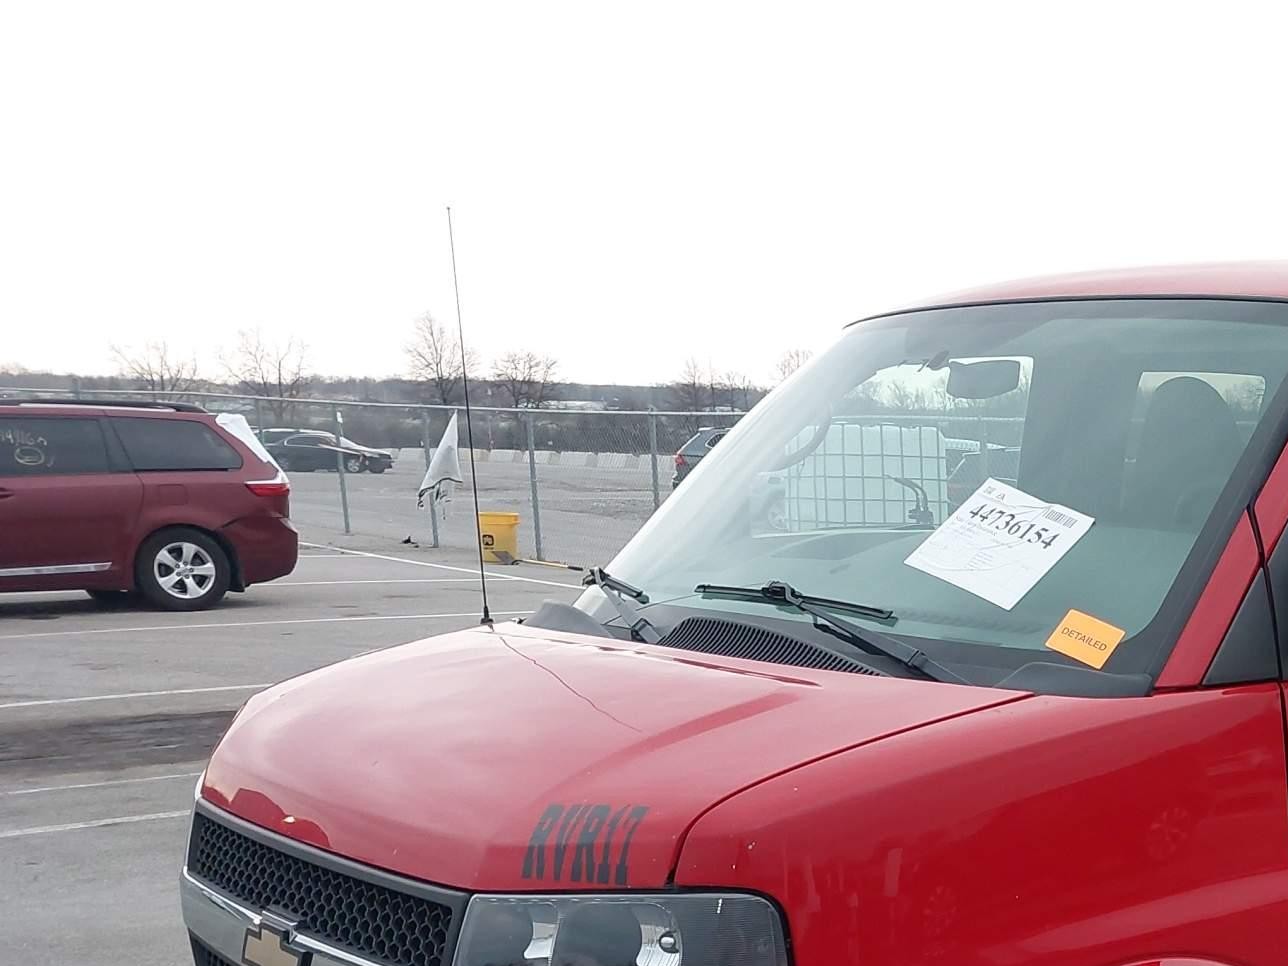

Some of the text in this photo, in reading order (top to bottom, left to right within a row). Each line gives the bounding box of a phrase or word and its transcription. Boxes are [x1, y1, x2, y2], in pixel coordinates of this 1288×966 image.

[969, 503, 1061, 549] 44736154
[1060, 626, 1108, 652] DETAILED
[521, 803, 650, 885] RVR17
